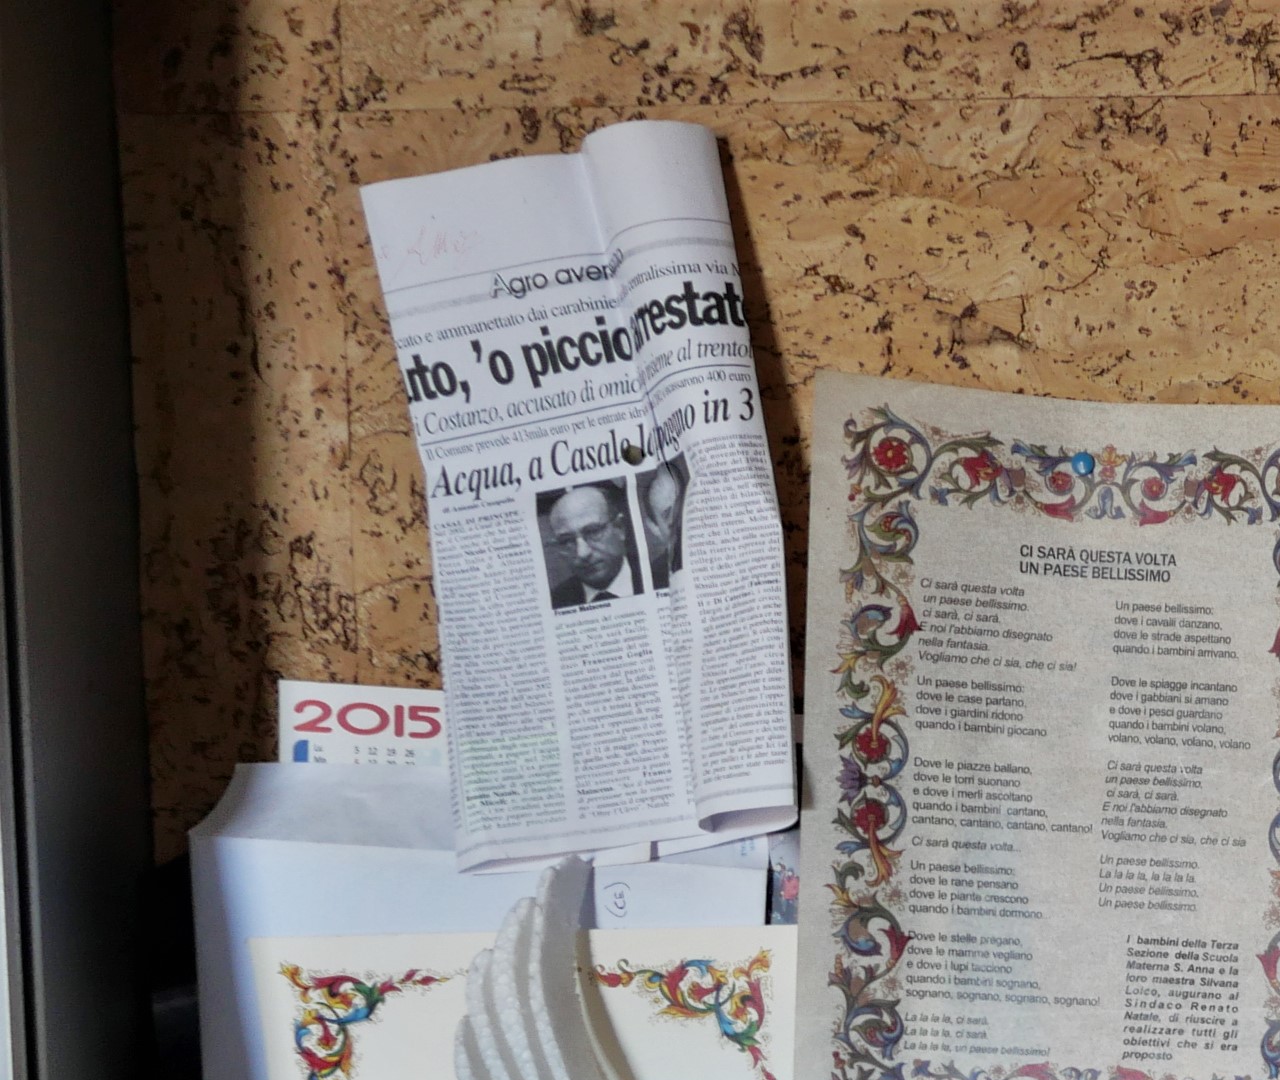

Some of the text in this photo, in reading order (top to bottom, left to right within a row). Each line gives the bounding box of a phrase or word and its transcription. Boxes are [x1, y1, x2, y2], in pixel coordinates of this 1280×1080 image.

[490, 271, 548, 299] Agro
[580, 379, 596, 402] di
[703, 387, 754, 424] in 3
[430, 461, 522, 501] Acqua,
[529, 456, 543, 481] a
[1019, 542, 1177, 567] CI SARÀ QUESTA VOLTA
[1019, 561, 1171, 583] UN PAESE BELLISSIMO
[293, 699, 442, 739] 2015
